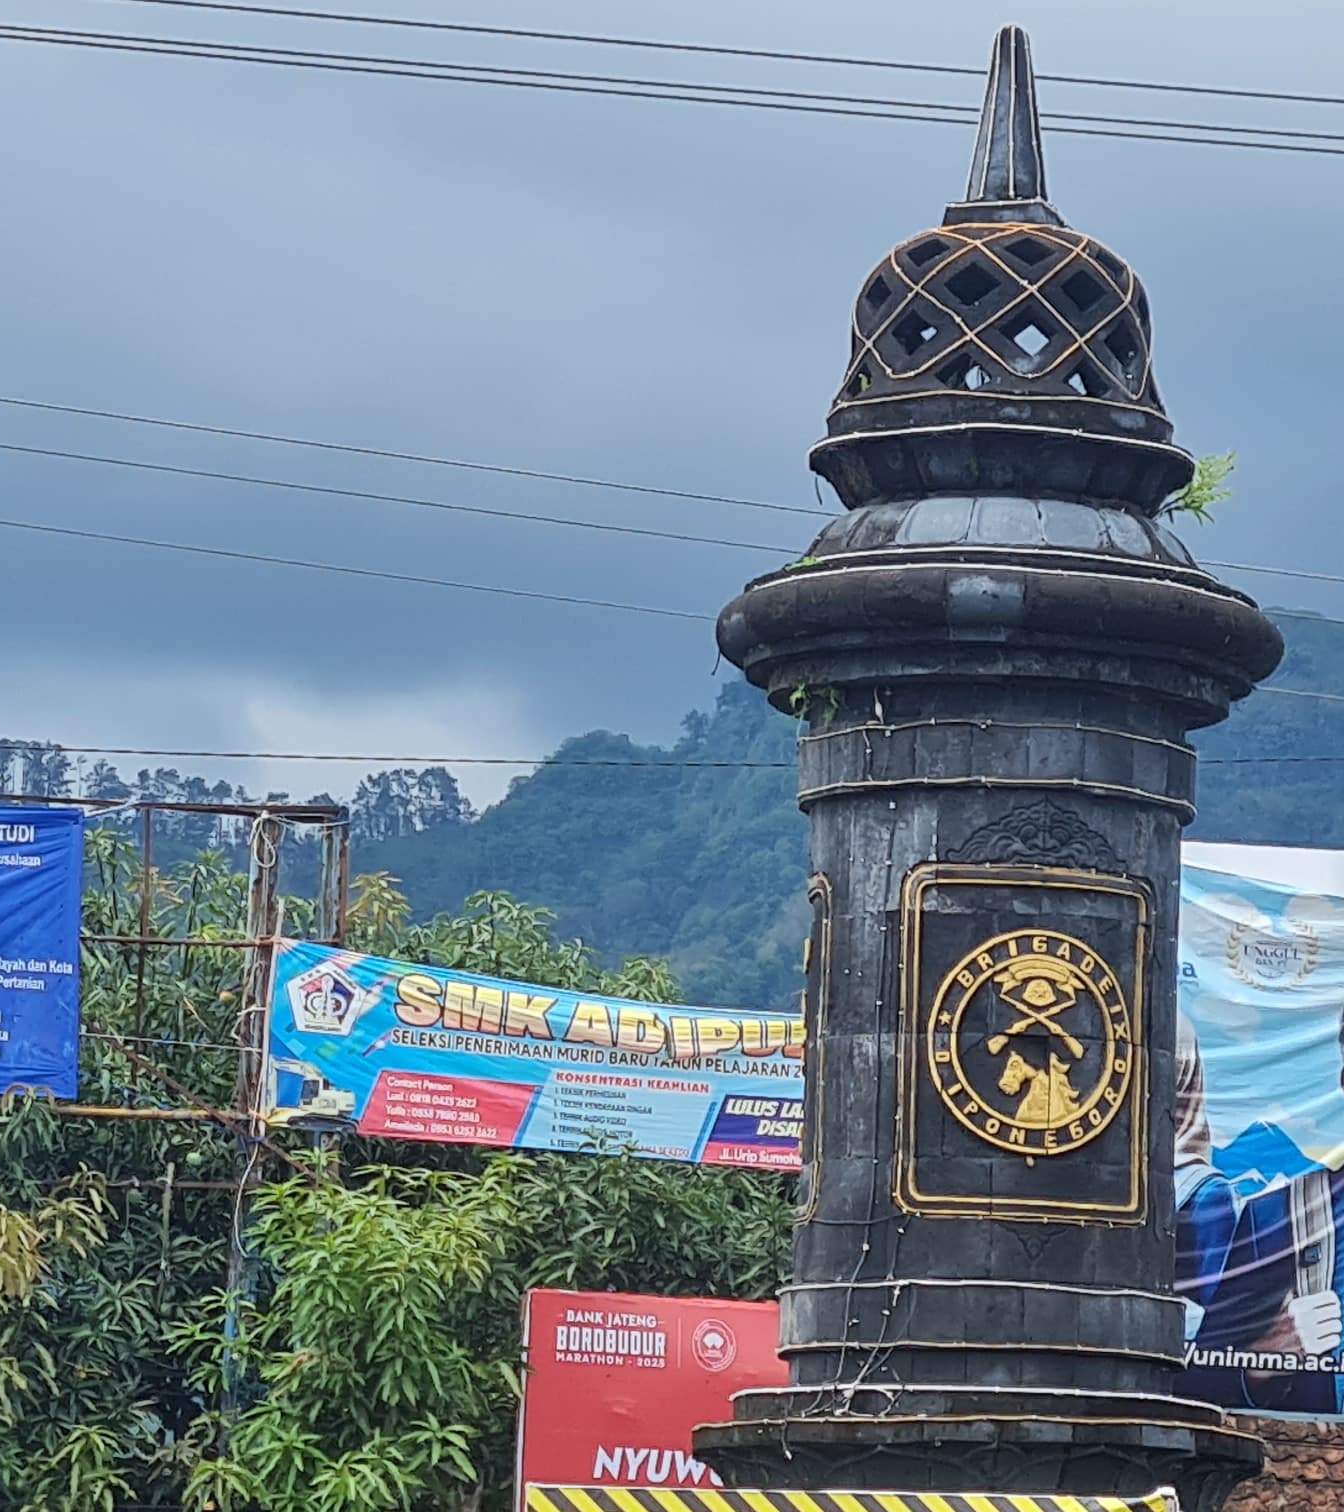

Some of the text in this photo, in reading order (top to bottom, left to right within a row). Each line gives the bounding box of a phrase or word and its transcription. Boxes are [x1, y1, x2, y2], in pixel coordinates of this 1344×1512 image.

[957, 936, 1114, 993] BRIGADE
[394, 972, 558, 1041] SMK
[391, 1028, 453, 1049] SELEKSI
[456, 1036, 553, 1061] PENERIMAAN
[556, 1047, 605, 1064] MURID
[609, 1050, 649, 1067] BARU
[705, 1057, 791, 1077] PELAJARAN
[556, 1071, 710, 1094] KONSENTRASI KEAHLIAN
[725, 1098, 805, 1119] LULUS LA
[935, 1049, 1126, 1149] DIPONEGORO
[566, 1309, 656, 1329] BANK JATENG
[556, 1325, 666, 1357] BOROBUDUR
[556, 1353, 624, 1366] MARATHON
